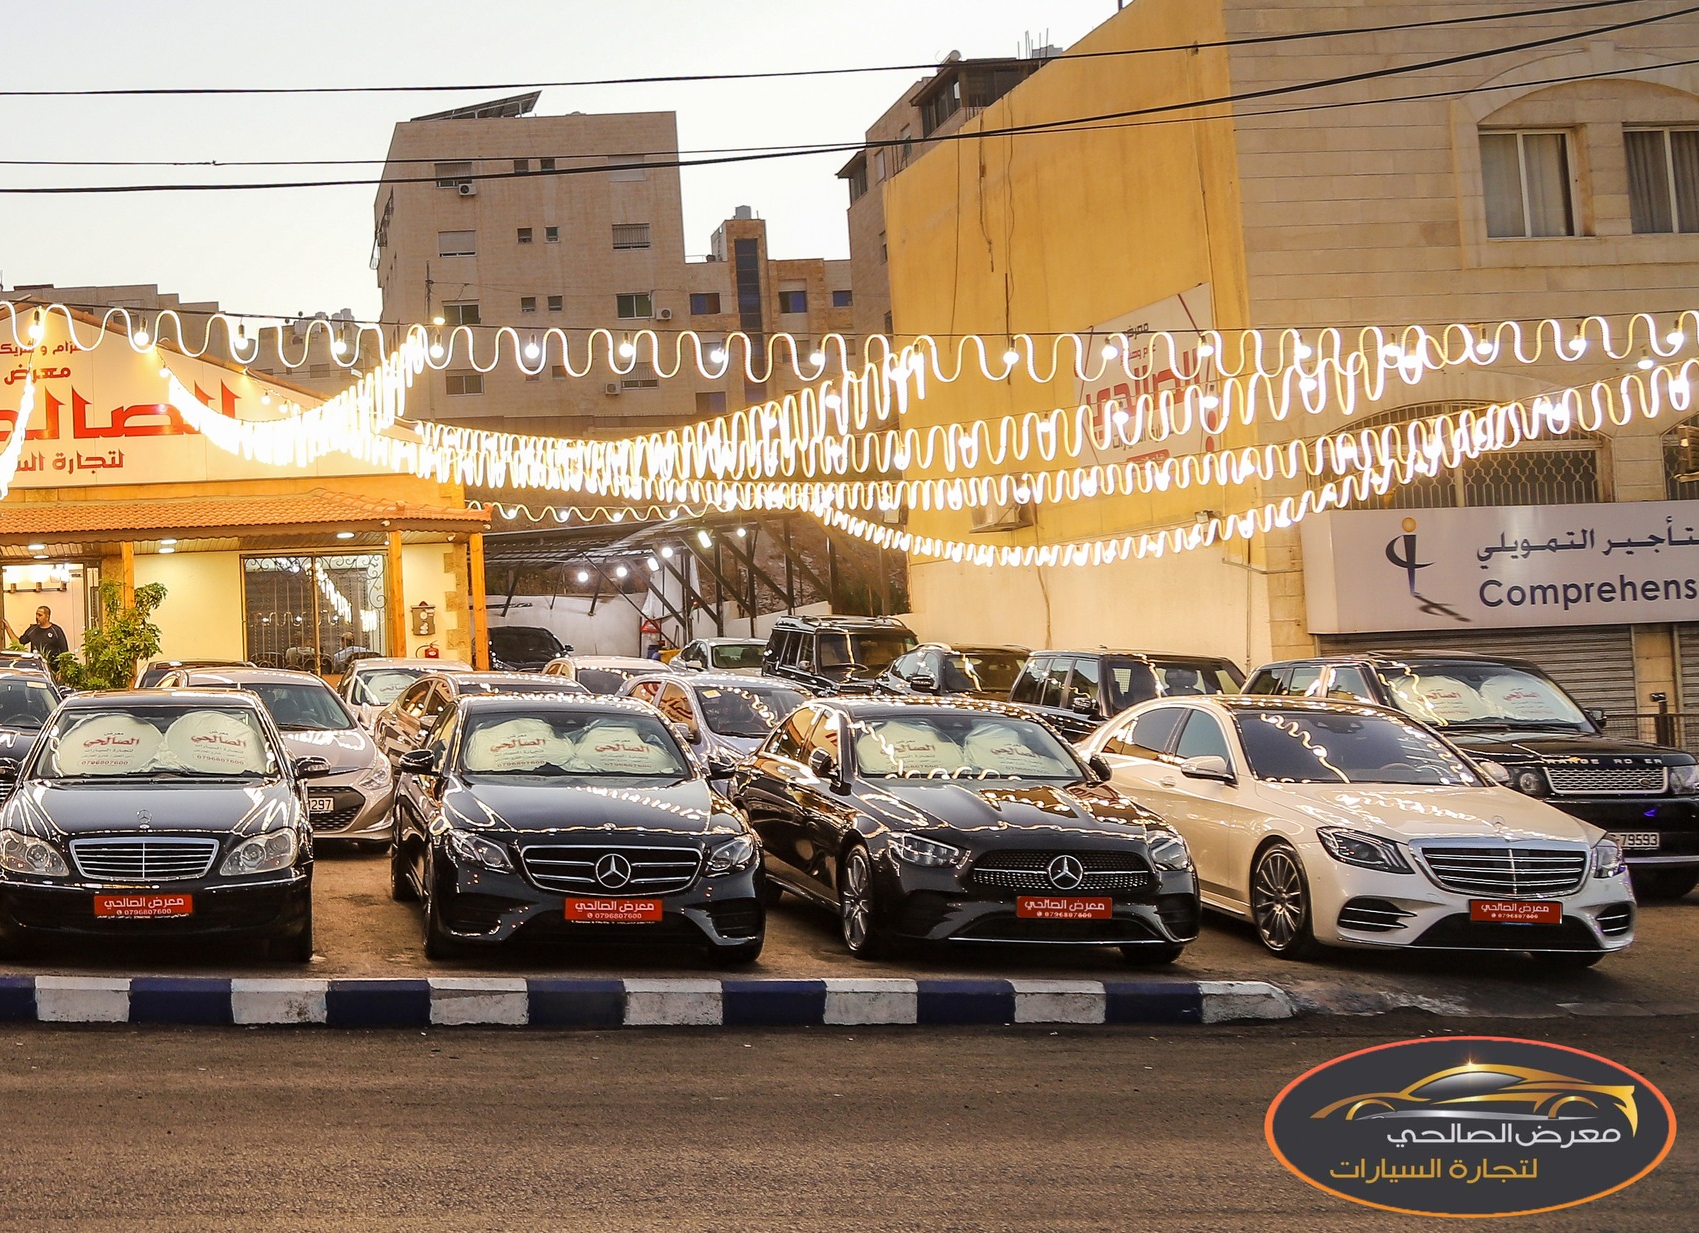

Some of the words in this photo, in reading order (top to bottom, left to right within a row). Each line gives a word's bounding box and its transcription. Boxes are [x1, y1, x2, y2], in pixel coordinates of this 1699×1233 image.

[52, 449, 125, 475] لتجارة
[1477, 528, 1595, 570] التمويلي
[1478, 574, 1698, 611] Comprehens
[83, 737, 140, 748] الصالحي
[191, 734, 247, 748] الصالحي
[490, 738, 547, 752] الصالحي
[594, 743, 650, 753] الصالحي
[308, 800, 332, 810] 297
[104, 897, 146, 910] الصالحي
[147, 896, 184, 909] معرض
[574, 900, 617, 912] الصالحي
[618, 900, 655, 913] معرض
[1024, 899, 1067, 911] الصالحي
[1068, 900, 1105, 912] معرض
[1481, 902, 1517, 912] الصالحي
[1518, 903, 1550, 914] معرض
[124, 908, 172, 916] 0796807600
